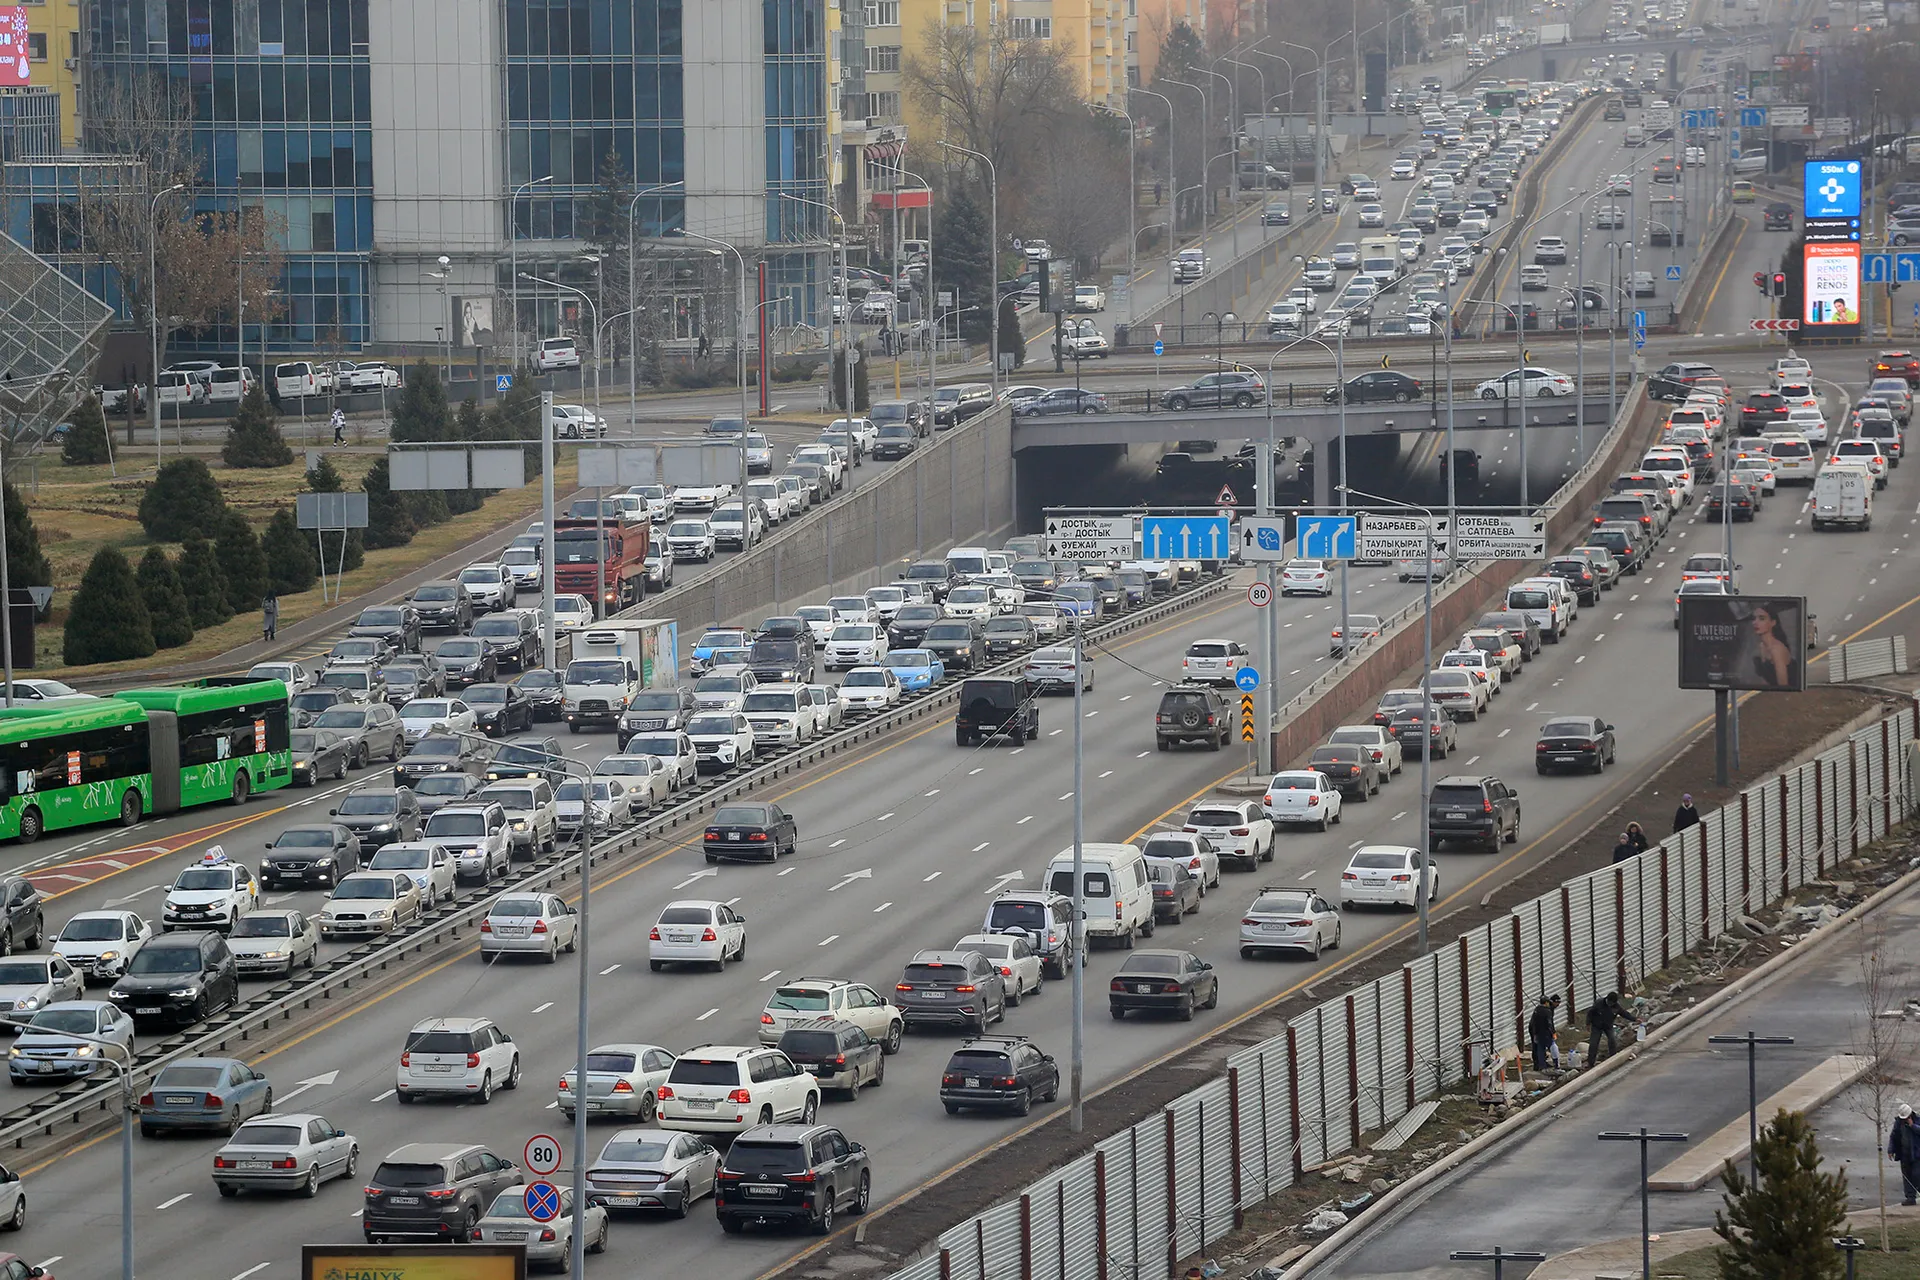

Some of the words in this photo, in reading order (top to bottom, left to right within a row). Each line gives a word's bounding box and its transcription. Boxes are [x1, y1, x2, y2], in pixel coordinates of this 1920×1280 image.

[1821, 166, 1844, 174] 550м
[1817, 265, 1848, 273] RENO5
[1817, 274, 1848, 282] RENO5
[1365, 522, 1416, 530] НАЗАРБАЕВ
[1458, 518, 1499, 526] СӘТБАЕВ
[1061, 540, 1097, 549] ӘУЕЖАЙ
[1121, 546, 1130, 554] R1
[1365, 549, 1400, 557] ГОРНЫЙ
[1401, 549, 1427, 557] ГИГАН
[1253, 589, 1266, 599] 80
[1693, 624, 1738, 636] L'INTERDIT
[533, 1147, 553, 1163] 80
